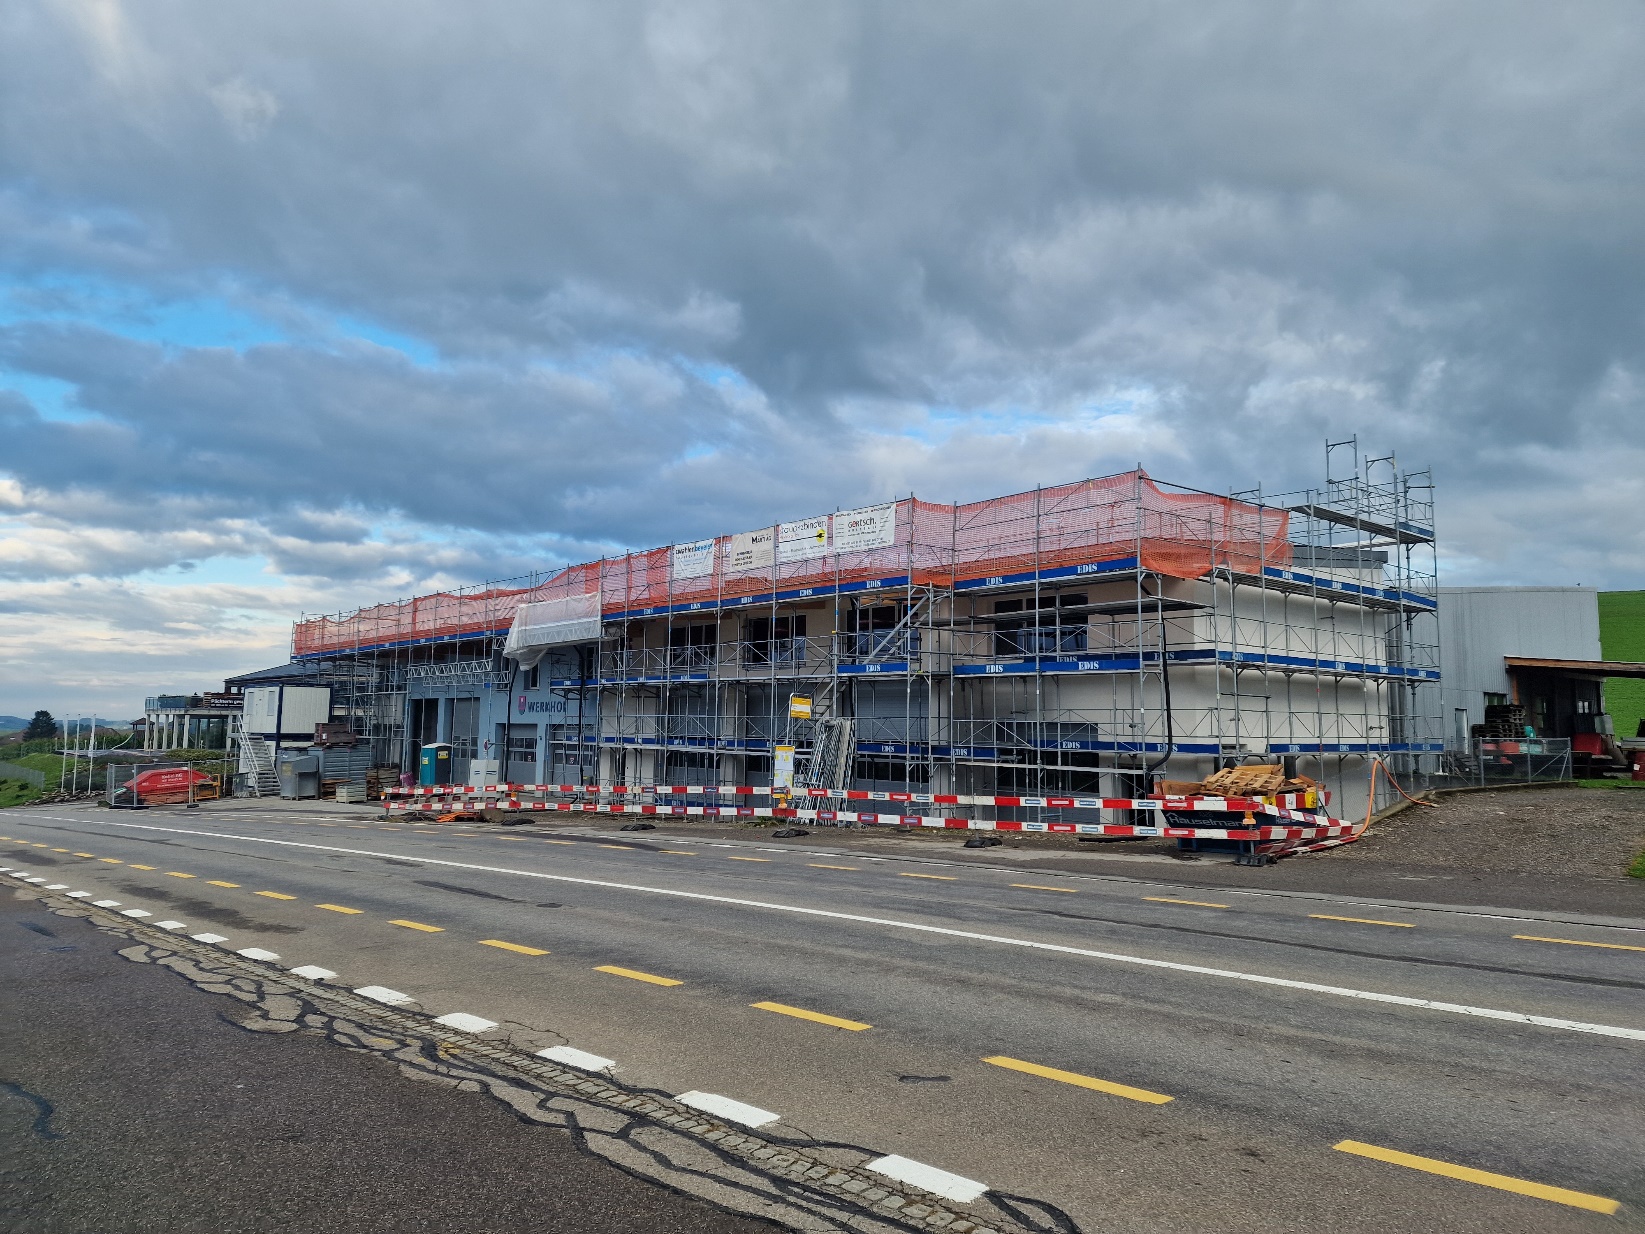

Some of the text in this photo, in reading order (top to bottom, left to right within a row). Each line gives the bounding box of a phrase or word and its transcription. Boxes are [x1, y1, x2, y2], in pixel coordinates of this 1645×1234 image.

[1077, 563, 1097, 573] EDIS
[866, 580, 881, 589] EDIS
[986, 576, 1003, 586] EDIS
[1154, 652, 1175, 660] EIS
[866, 664, 881, 672] EDIS
[986, 664, 1003, 673] EDIS
[1078, 661, 1099, 670] EDIS
[1062, 741, 1080, 749] EDIS
